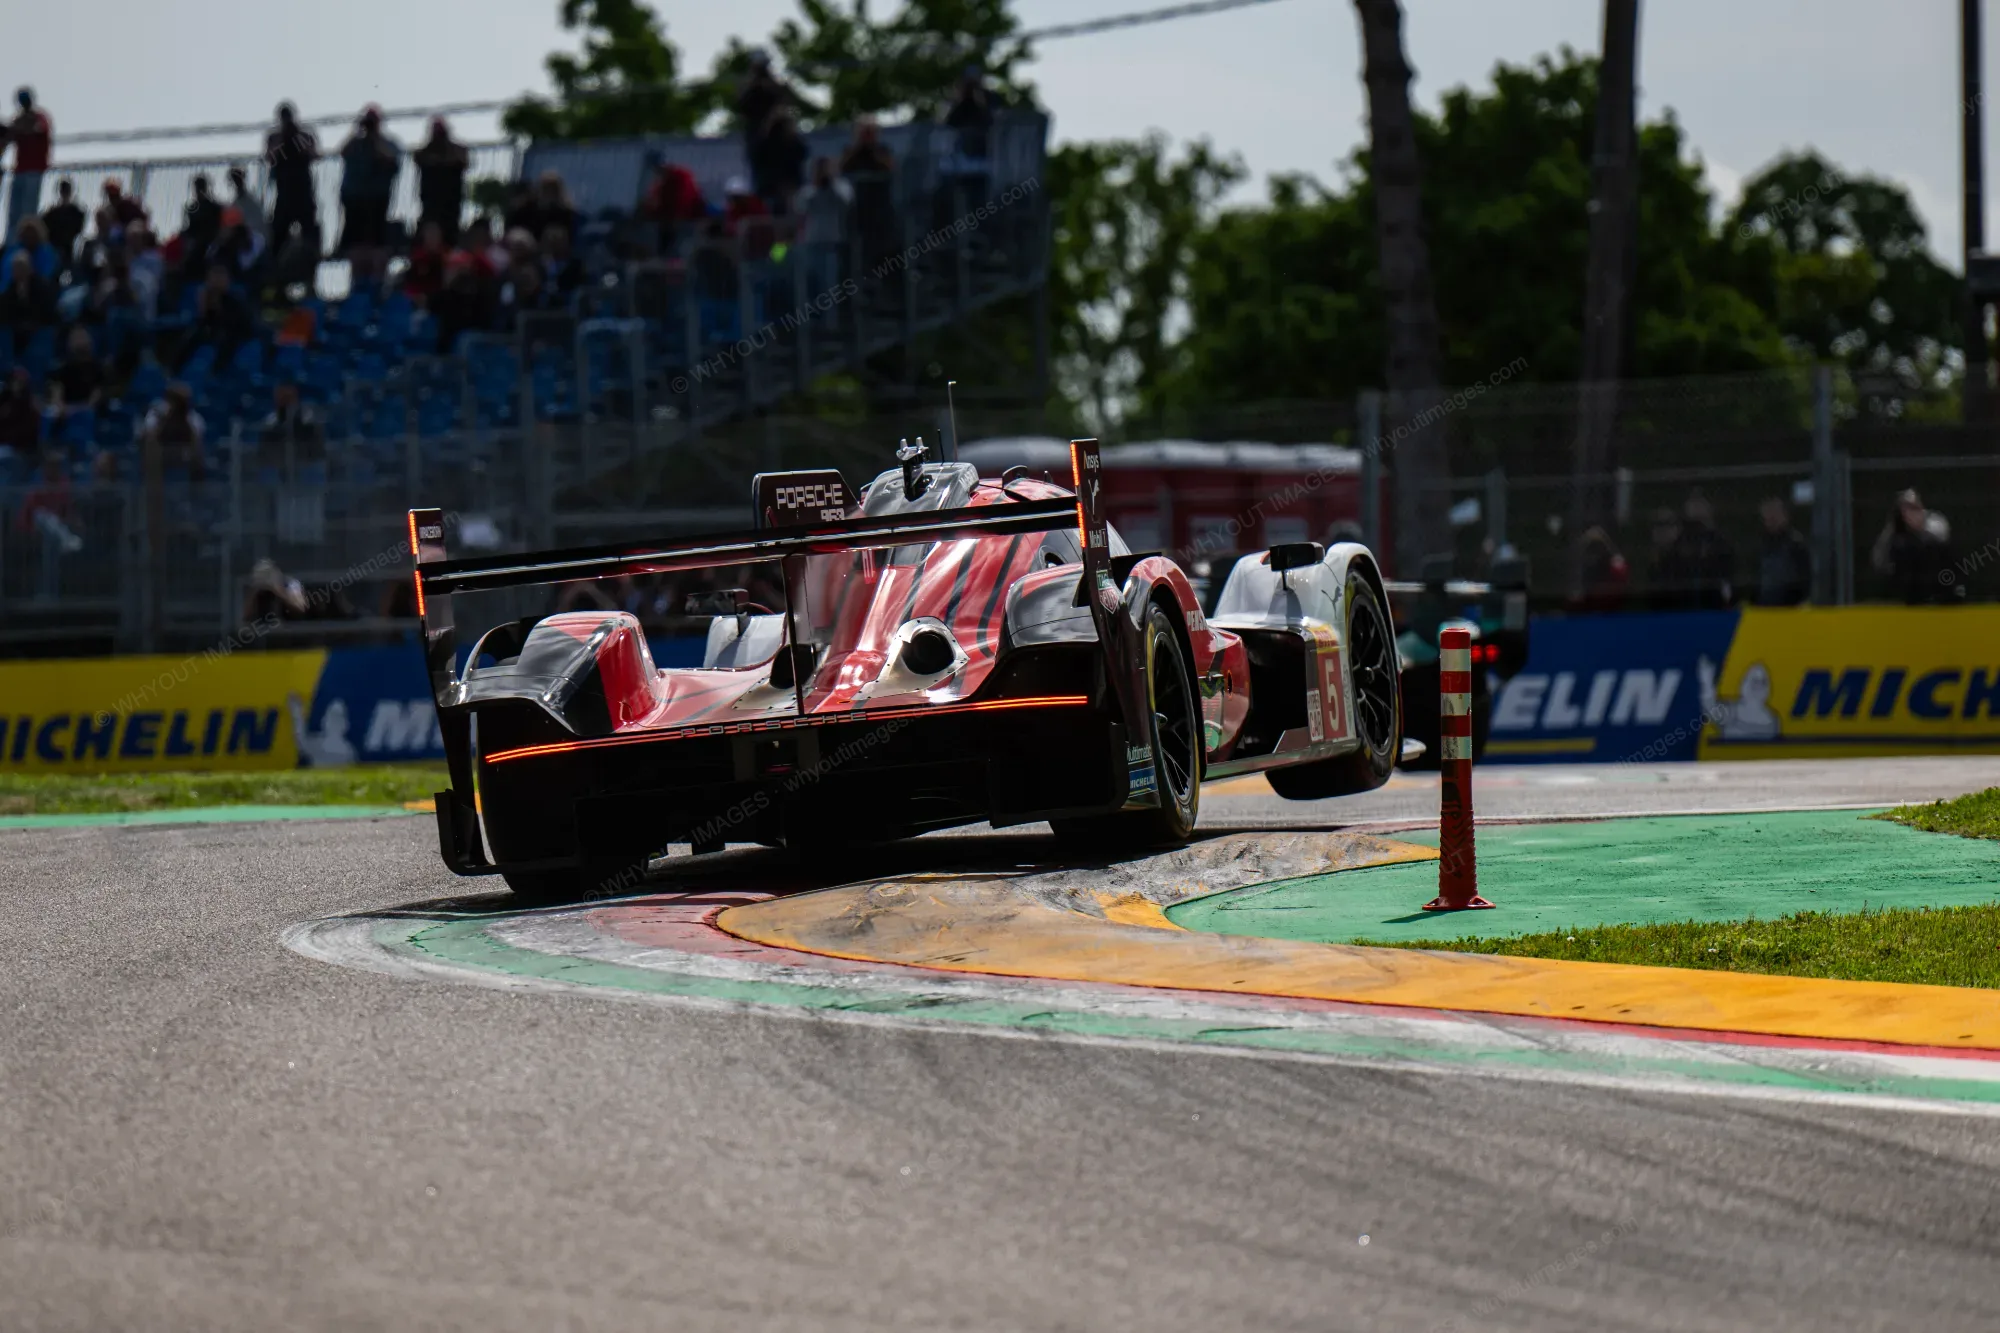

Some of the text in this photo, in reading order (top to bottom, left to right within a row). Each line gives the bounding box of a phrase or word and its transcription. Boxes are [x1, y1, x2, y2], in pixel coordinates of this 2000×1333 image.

[776, 483, 843, 509] PORSCHE
[820, 507, 845, 522] 963
[1325, 658, 1340, 732] 5
[1491, 668, 1682, 730] ELIN
[1791, 668, 2000, 720] MICH
[680, 711, 867, 738] PORSCHE
